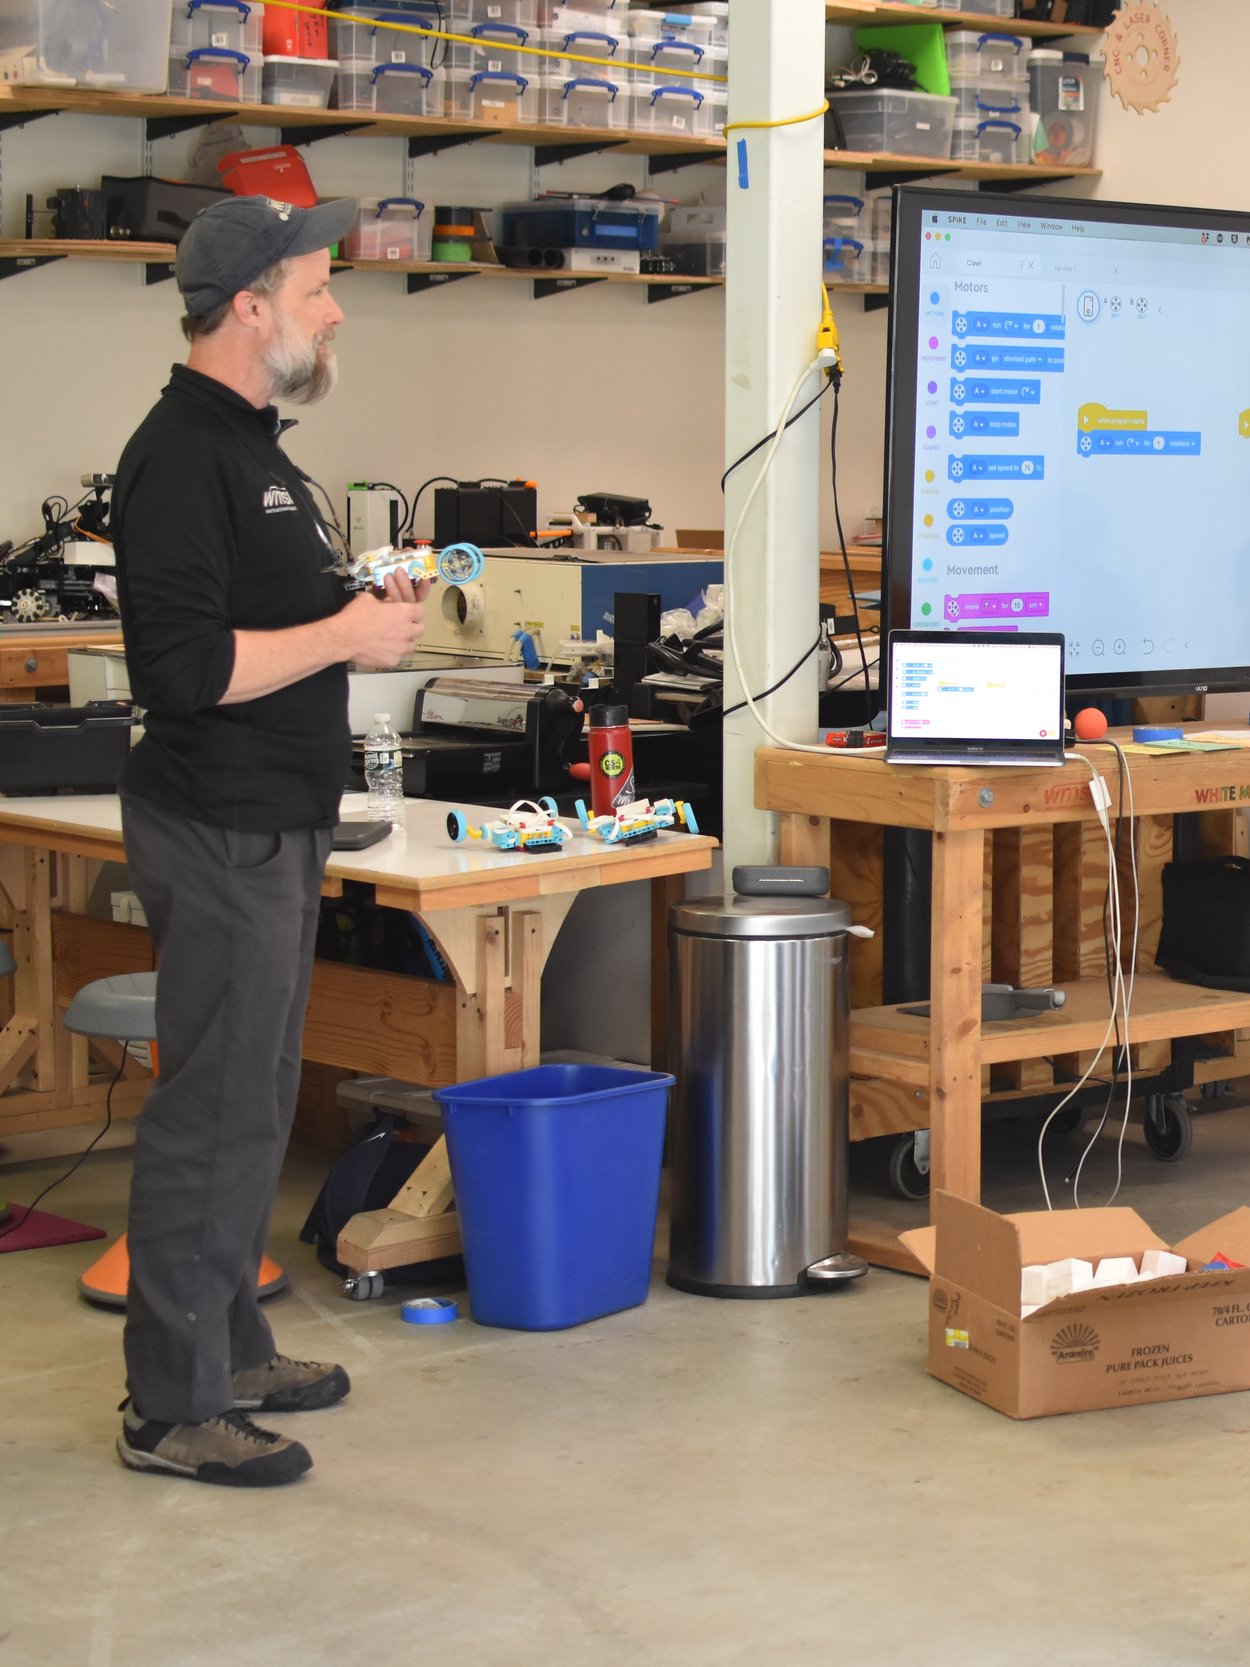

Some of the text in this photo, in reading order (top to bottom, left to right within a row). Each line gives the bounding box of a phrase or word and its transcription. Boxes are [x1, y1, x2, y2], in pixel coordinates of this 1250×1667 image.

[1113, 13, 1170, 75] CNC & LASER CORNER
[948, 216, 1085, 233] SPIKE File Edit View Window Help
[966, 259, 982, 267] Crawl
[954, 281, 989, 293] Motors
[1025, 355, 1036, 363] path
[990, 421, 1001, 429] stop
[1111, 418, 1131, 426] program
[998, 464, 1013, 472] speed
[990, 506, 1010, 514] position
[989, 532, 1005, 540] speed
[947, 564, 999, 576] Movement
[1195, 786, 1236, 804] WHITE
[1212, 1305, 1230, 1316] 70/4
[1231, 1303, 1245, 1315] FL.
[1058, 1348, 1094, 1360] Ardmore
[1131, 1344, 1170, 1358] FROZEN
[1106, 1354, 1194, 1373] PURE PACK JUICES
